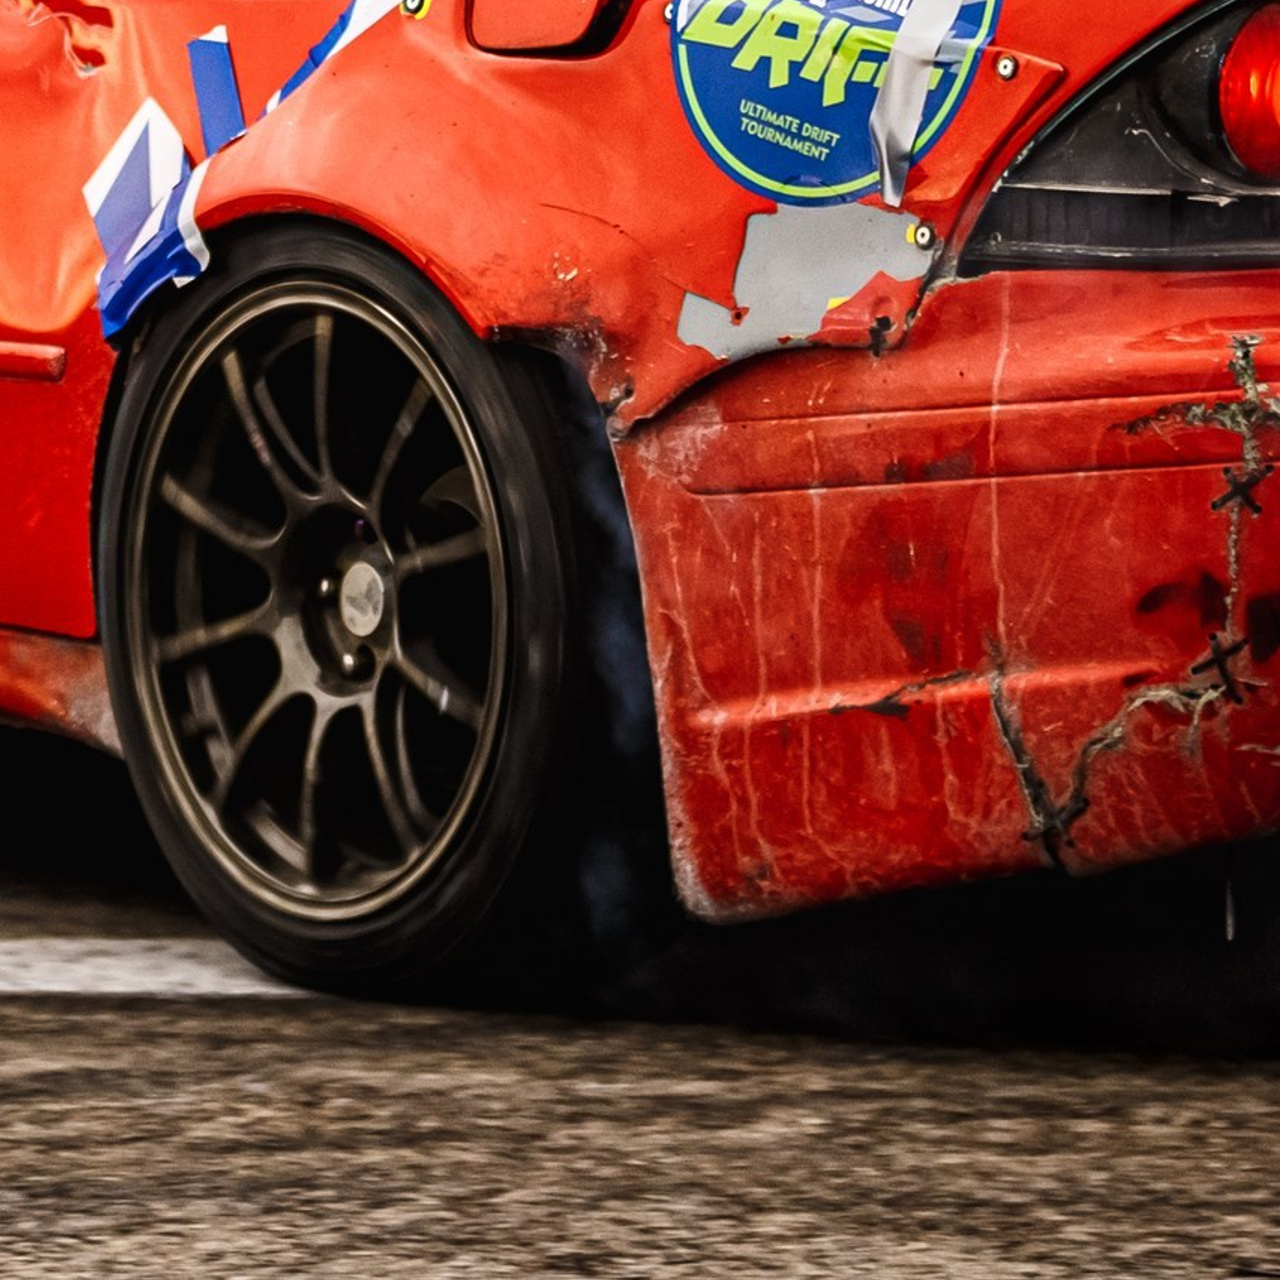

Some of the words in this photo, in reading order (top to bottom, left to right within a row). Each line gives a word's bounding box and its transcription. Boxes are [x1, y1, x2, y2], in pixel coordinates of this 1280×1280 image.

[739, 98, 800, 133] ULTIMATE
[801, 122, 841, 148] DRIFT
[740, 116, 831, 161] TOURNAMENT
